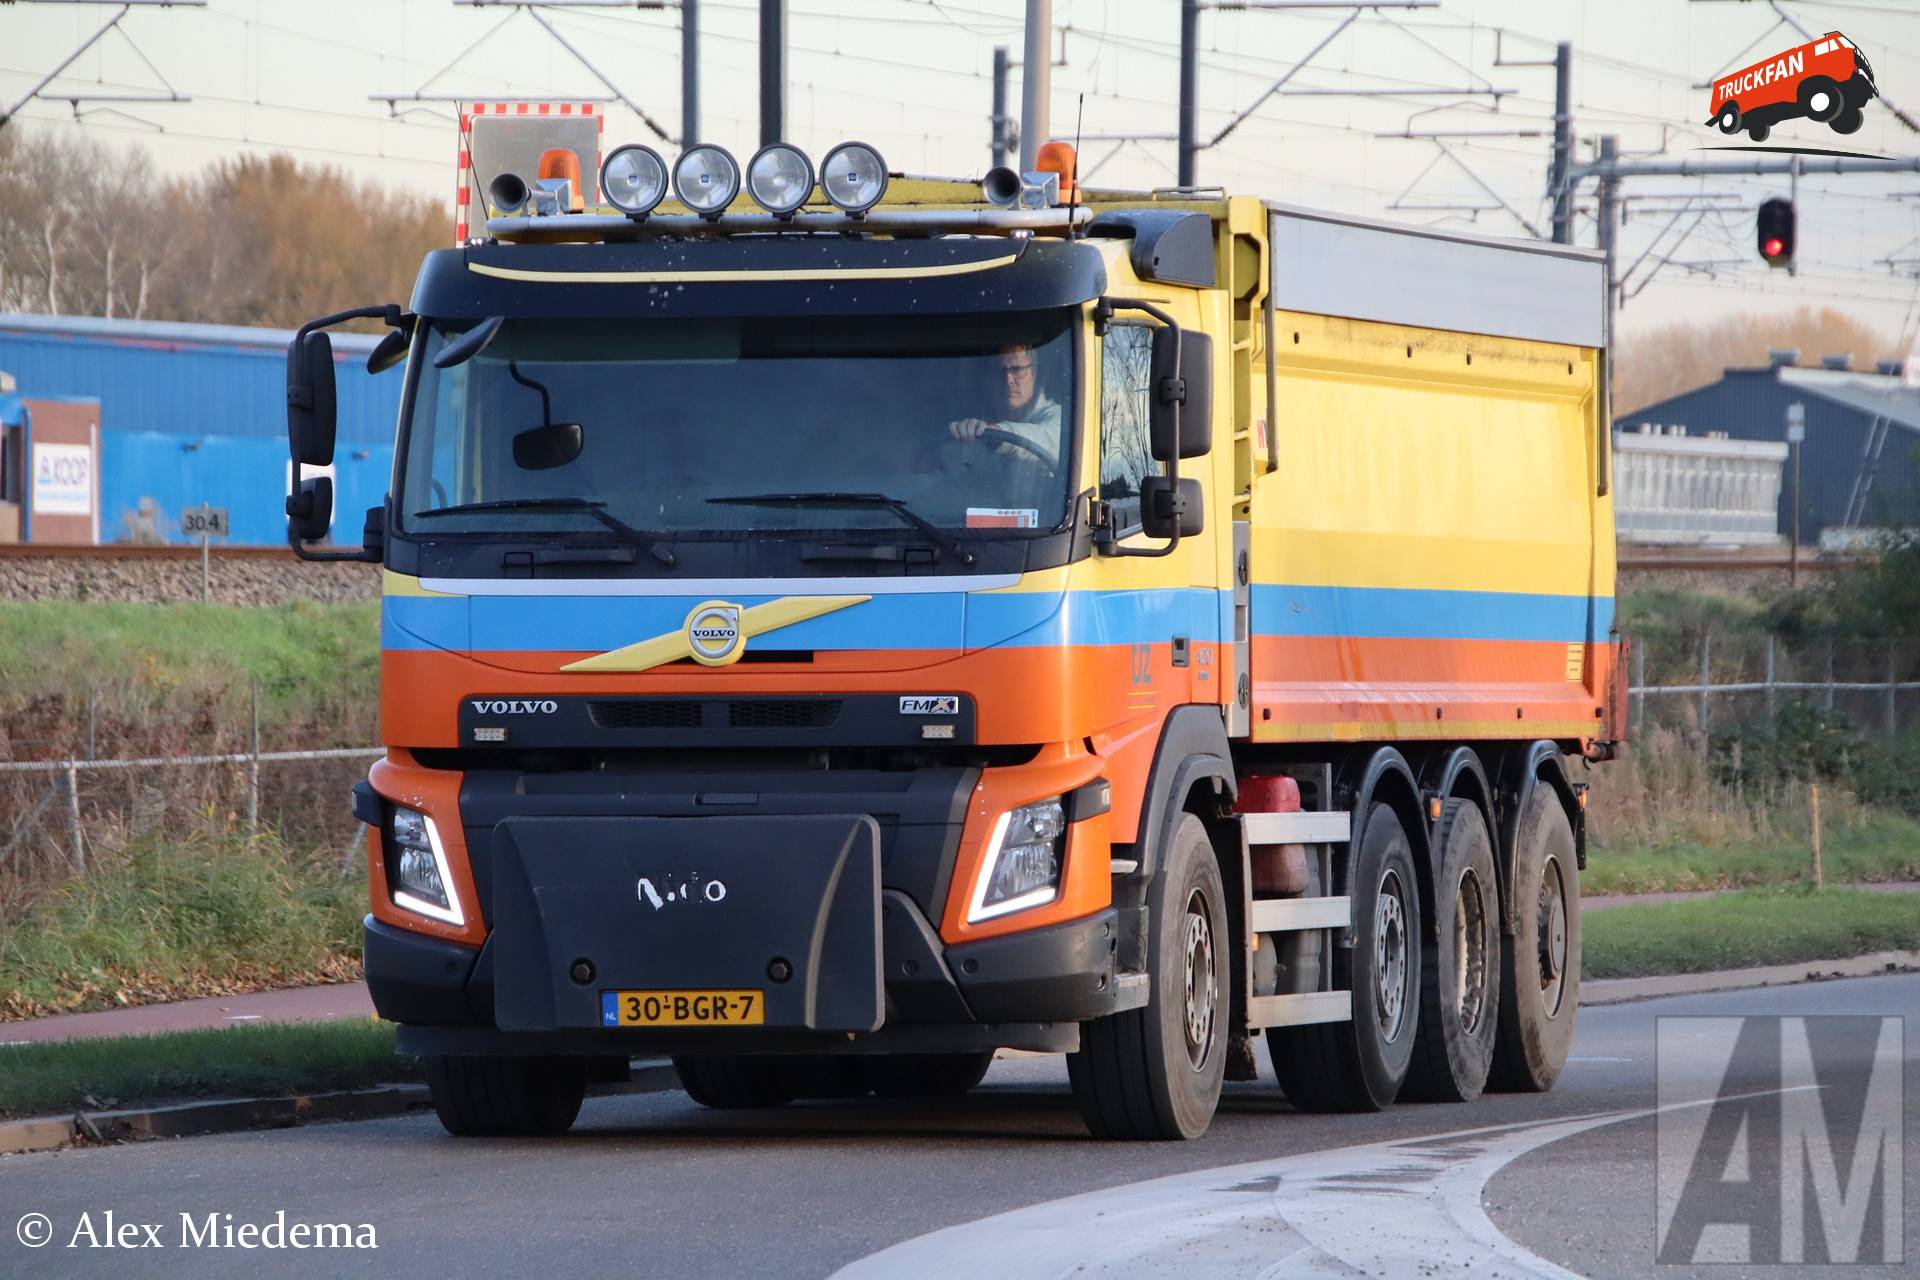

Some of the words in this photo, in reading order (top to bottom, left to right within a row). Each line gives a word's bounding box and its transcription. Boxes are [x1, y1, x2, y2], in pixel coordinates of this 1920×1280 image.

[693, 629, 735, 637] VOLVO
[471, 701, 558, 714] VOLVO
[901, 697, 956, 713] FMX
